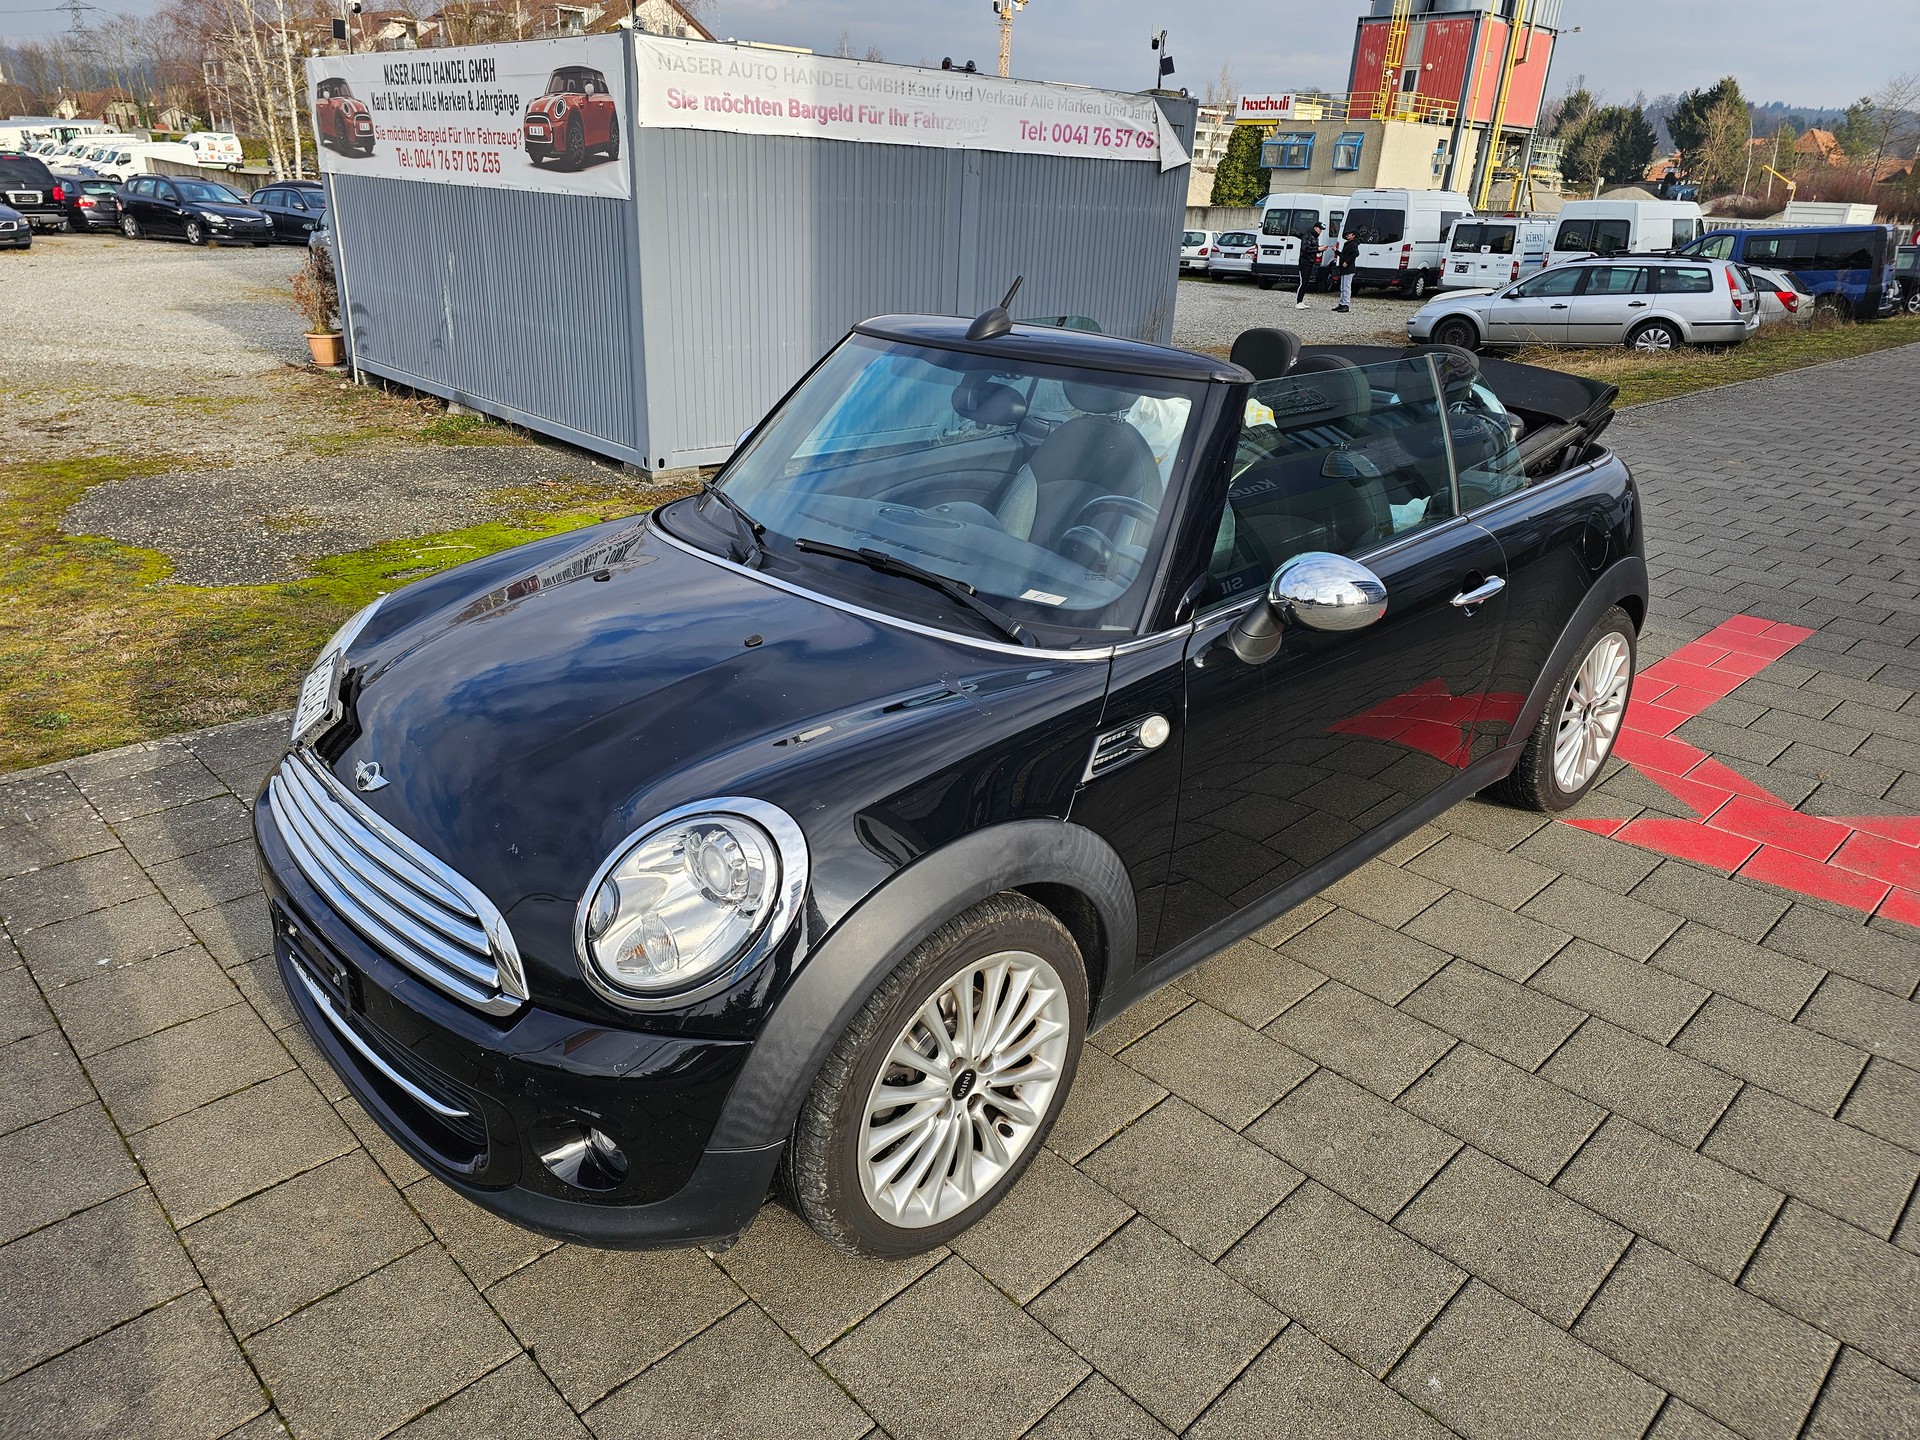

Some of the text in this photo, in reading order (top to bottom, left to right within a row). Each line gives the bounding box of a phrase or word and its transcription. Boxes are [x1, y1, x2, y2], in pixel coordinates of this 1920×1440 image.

[384, 58, 496, 86] NASER AUTO HANDEL GMBH
[658, 52, 723, 76] NASER
[728, 60, 778, 81] AUTO
[783, 66, 853, 90] HANDEL
[858, 74, 905, 95] GMBH
[908, 80, 942, 98] Kauf
[945, 84, 973, 102] Und
[977, 87, 1028, 107] Verkauf
[1030, 94, 1054, 110] Alle
[1057, 98, 1101, 115] Marken
[1103, 102, 1127, 117] Und
[371, 88, 520, 116] Kauf & Verkauf Alle Marken & Jahrgänge
[667, 87, 698, 110] Sie
[704, 91, 783, 116] möchten
[788, 98, 854, 126] Bargeld
[858, 104, 885, 125] Für
[889, 107, 910, 127] Ihr
[375, 125, 386, 141] Sie
[387, 125, 417, 142] möchten
[418, 126, 447, 147] Bargeld
[448, 127, 462, 144] Für
[463, 127, 476, 145] Ihr
[477, 127, 522, 150] Fahrzeug?
[1019, 119, 1155, 149] Tel: 0041 76 57 05
[395, 147, 501, 174] Tel: 0041 76 57 05 255
[957, 1072, 972, 1098] MINI
